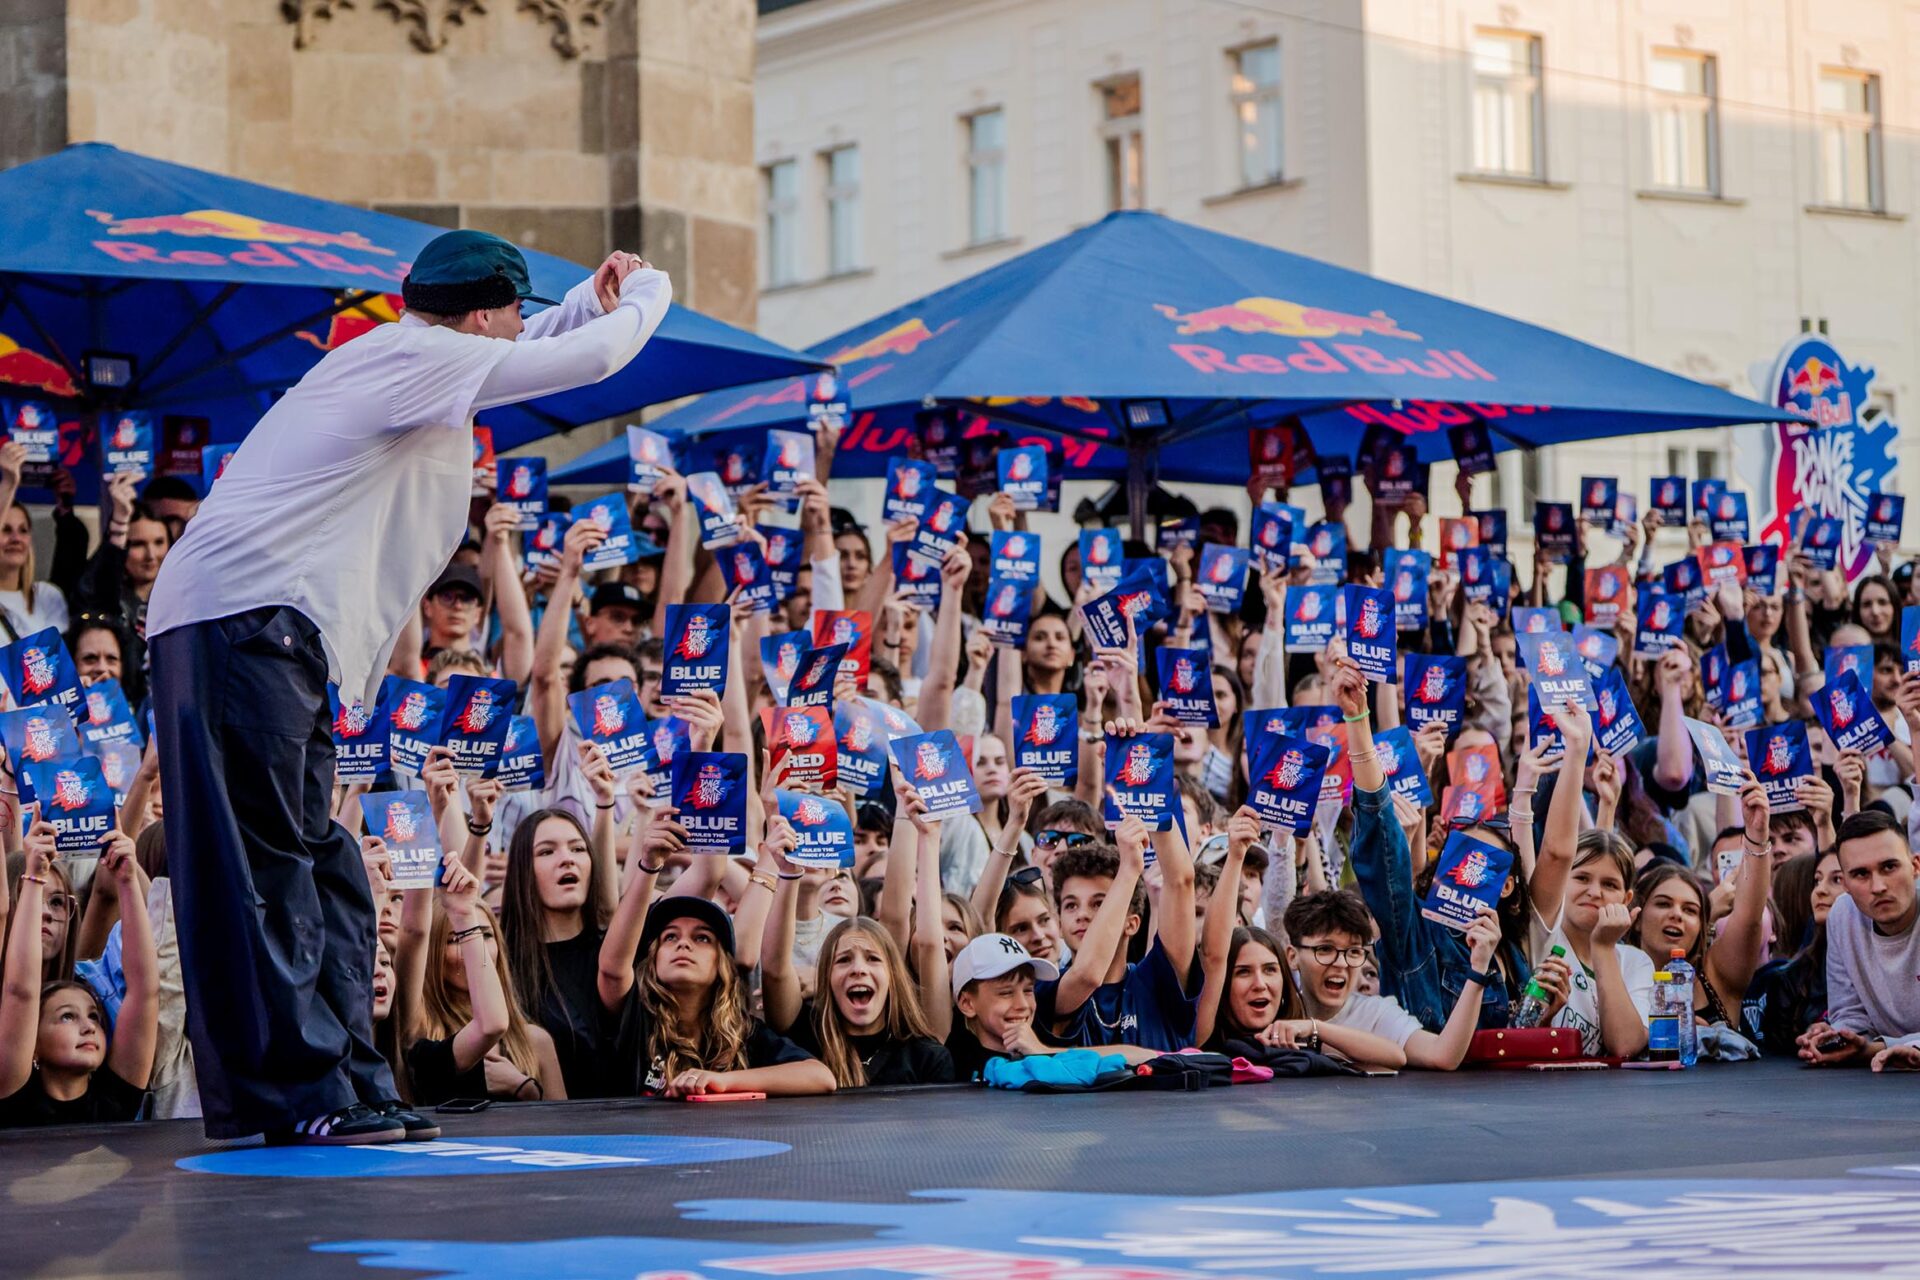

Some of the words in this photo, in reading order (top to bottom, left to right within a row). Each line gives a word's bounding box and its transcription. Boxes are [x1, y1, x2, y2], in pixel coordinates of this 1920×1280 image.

[92, 240, 299, 268] Red
[288, 246, 411, 282] Bu
[1169, 341, 1350, 373] Red
[1332, 342, 1497, 382] Bull
[1820, 392, 1853, 430] Bull
[13, 431, 55, 445] BLUE
[108, 451, 149, 463] BLUE
[1792, 431, 1855, 494] DANCE
[887, 499, 925, 515] BLUE
[996, 559, 1035, 572] BLUE
[1097, 601, 1127, 645] BLUE
[1291, 623, 1331, 636] BLUE
[1352, 642, 1391, 662] BLUE
[670, 665, 721, 680] BLUE
[1540, 679, 1586, 693] BLUE
[790, 691, 828, 707] BLUE
[1168, 697, 1211, 711] BLUE
[1410, 706, 1457, 722] BLUE
[87, 721, 134, 741] BLUE
[1602, 713, 1635, 747] BLUE
[1837, 717, 1879, 748] BLUE
[336, 744, 383, 758] BLUE
[447, 739, 498, 755] BLUE
[600, 733, 647, 756] BLUE
[497, 754, 536, 772] LUE
[787, 753, 825, 768] RED
[837, 753, 879, 777] BLUE
[1022, 751, 1072, 765] BLUE
[1321, 775, 1342, 787] ED
[917, 780, 970, 799] BLUE
[1113, 792, 1166, 807] BLUE
[1254, 790, 1309, 816] BLUE
[51, 815, 108, 834] BLUE
[680, 815, 738, 831] BLUE
[795, 831, 846, 846] BLUE
[387, 848, 436, 864] BLUE
[1436, 885, 1489, 912] BLUE
[999, 938, 1024, 954] NY
[348, 1142, 650, 1167] BLUE
